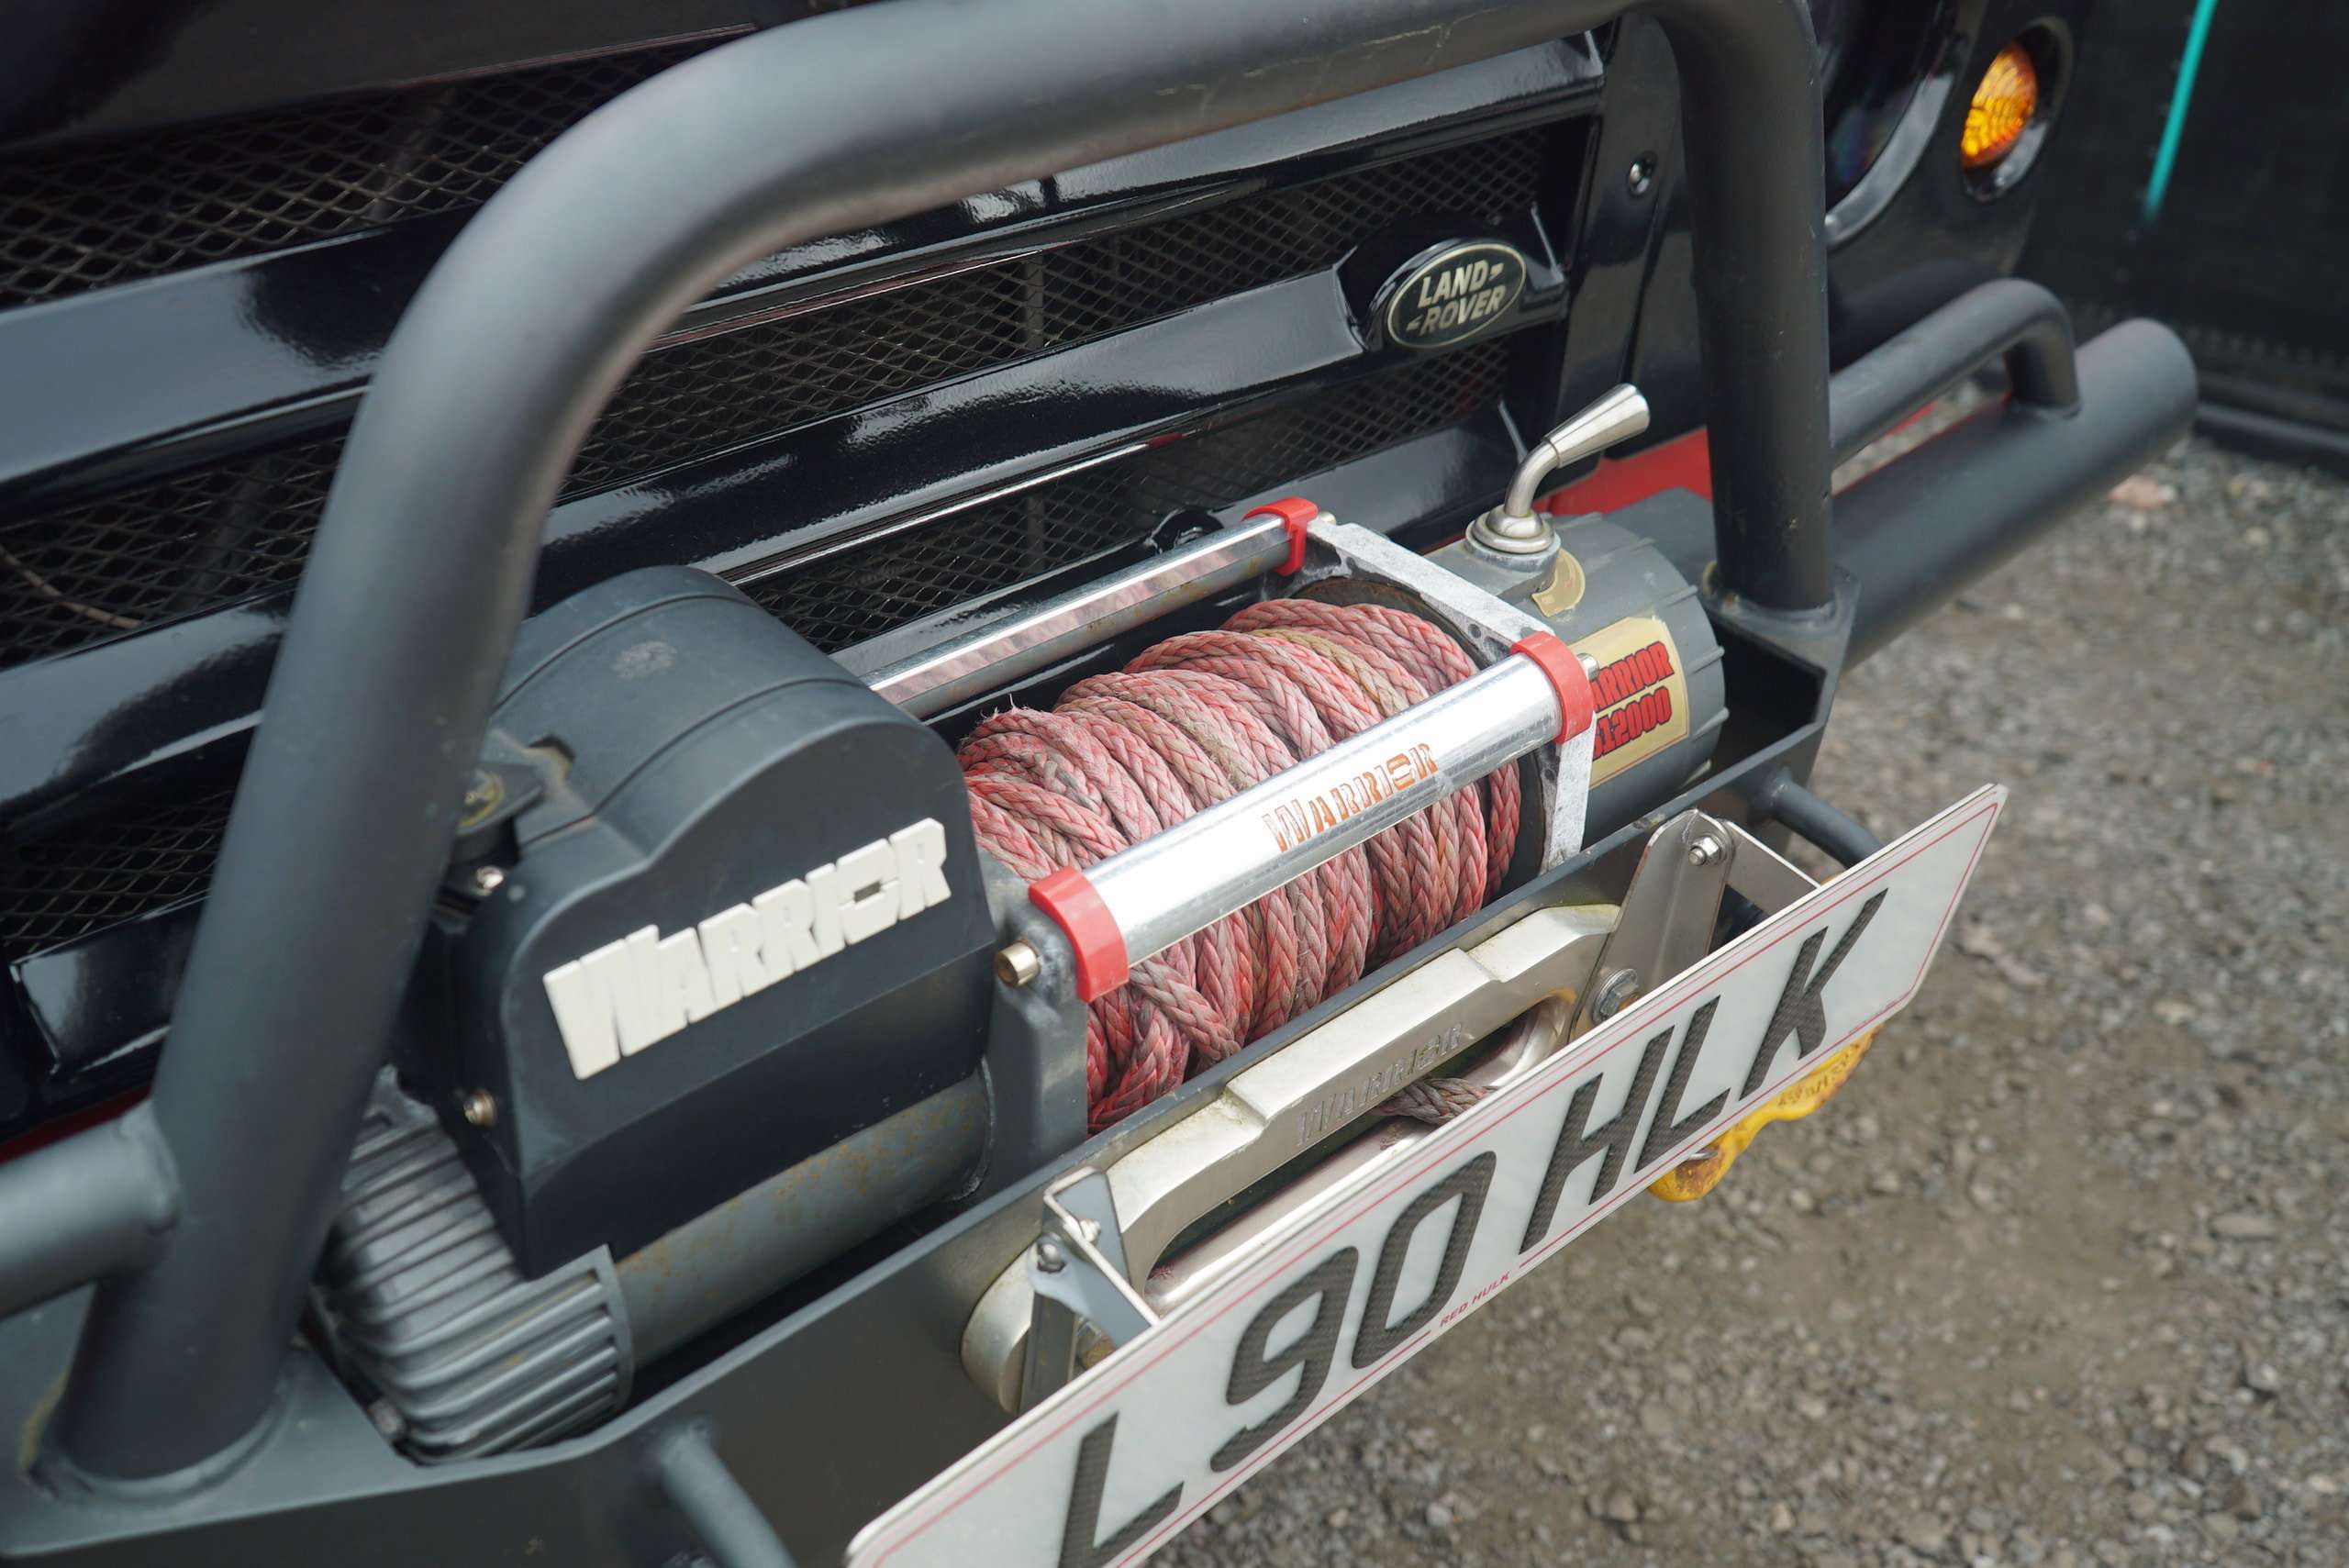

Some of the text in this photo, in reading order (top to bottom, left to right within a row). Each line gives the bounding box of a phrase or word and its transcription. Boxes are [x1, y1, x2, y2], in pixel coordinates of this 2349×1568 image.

[1418, 260, 1488, 308] LAND
[1419, 284, 1507, 336] ROVER
[1590, 642, 1675, 713] ARRIOR
[1262, 742, 1439, 852] WARRIOR
[542, 817, 952, 1081] WARRIOR
[1297, 1022, 1463, 1147] WARRIOR
[1058, 888, 1887, 1568] L90 HLK
[1439, 1271, 1511, 1328] RED HULK
